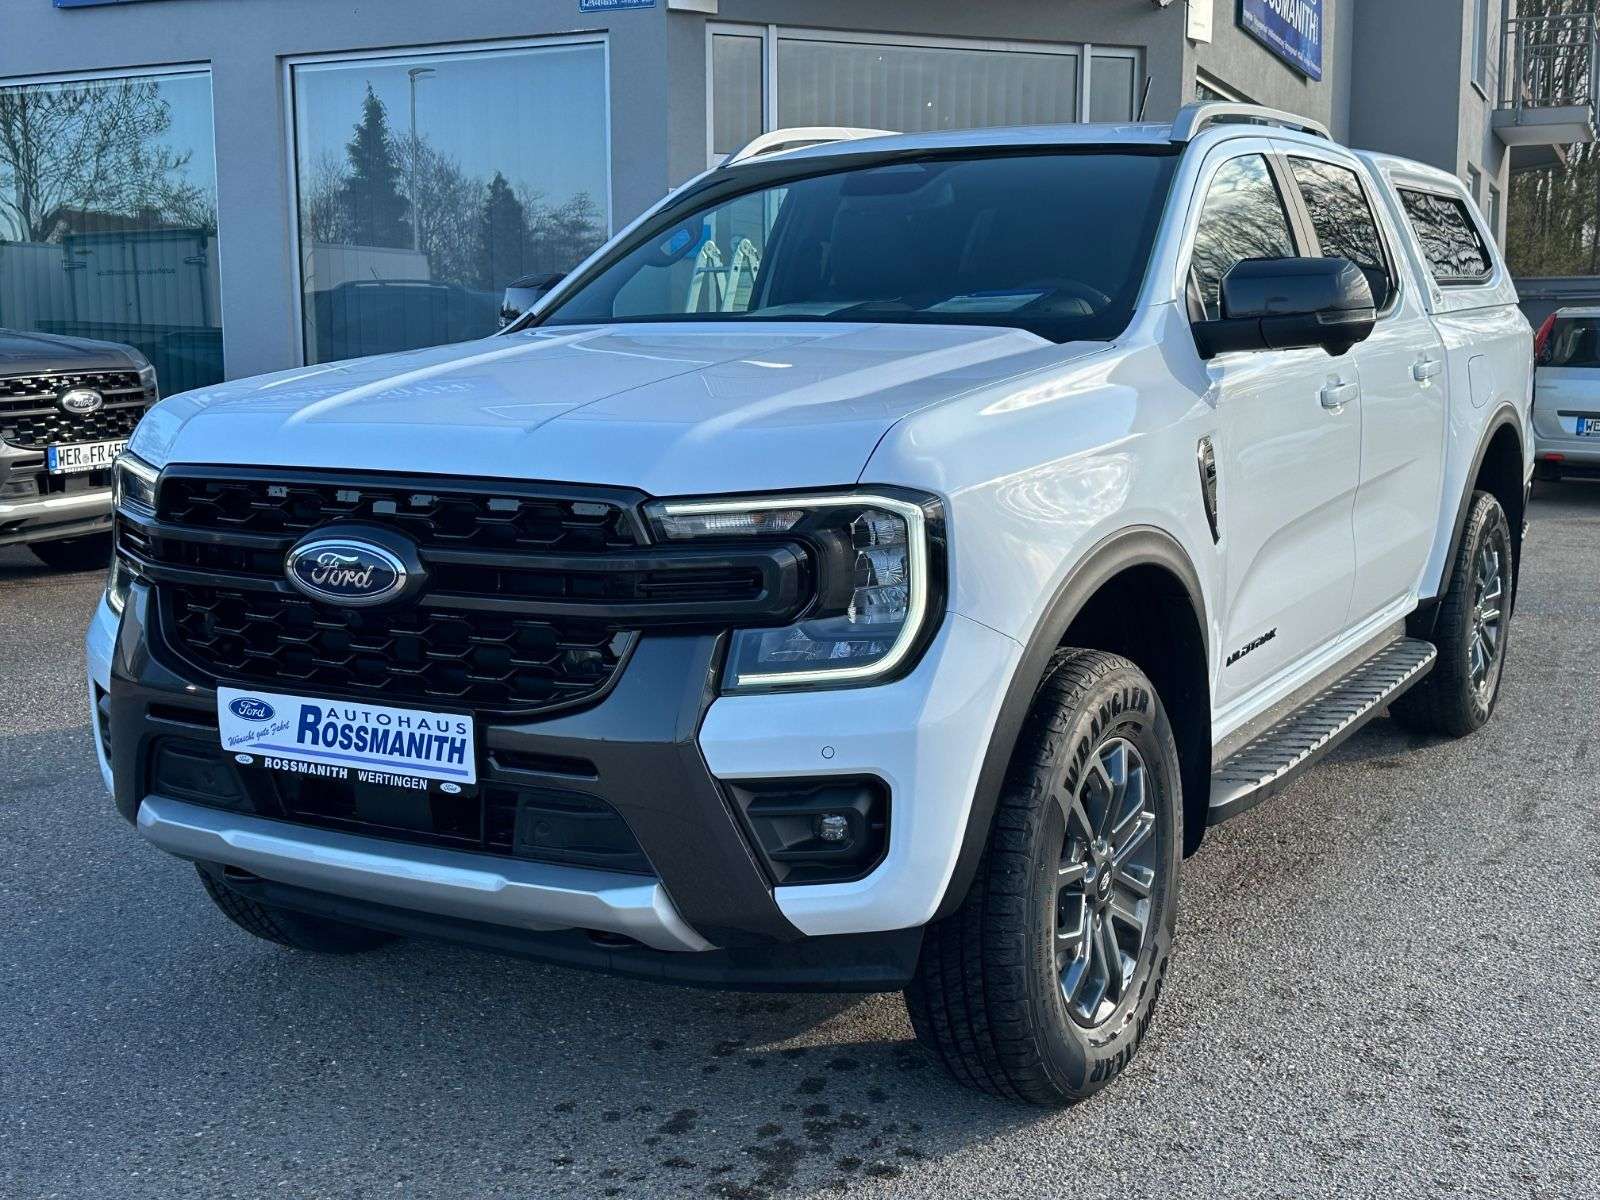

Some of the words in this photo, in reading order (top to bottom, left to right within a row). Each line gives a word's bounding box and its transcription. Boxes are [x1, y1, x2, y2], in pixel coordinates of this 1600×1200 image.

[58, 447, 81, 466] WER
[90, 445, 105, 462] FR
[311, 552, 374, 588] Ford
[238, 700, 265, 717] Ford
[326, 707, 467, 735] AUTOHAUS
[296, 704, 467, 764] ROSSMANITH
[1063, 686, 1149, 797] WRANGLER
[264, 757, 348, 779] ROSSMANITH
[358, 770, 428, 790] WERTINGEN
